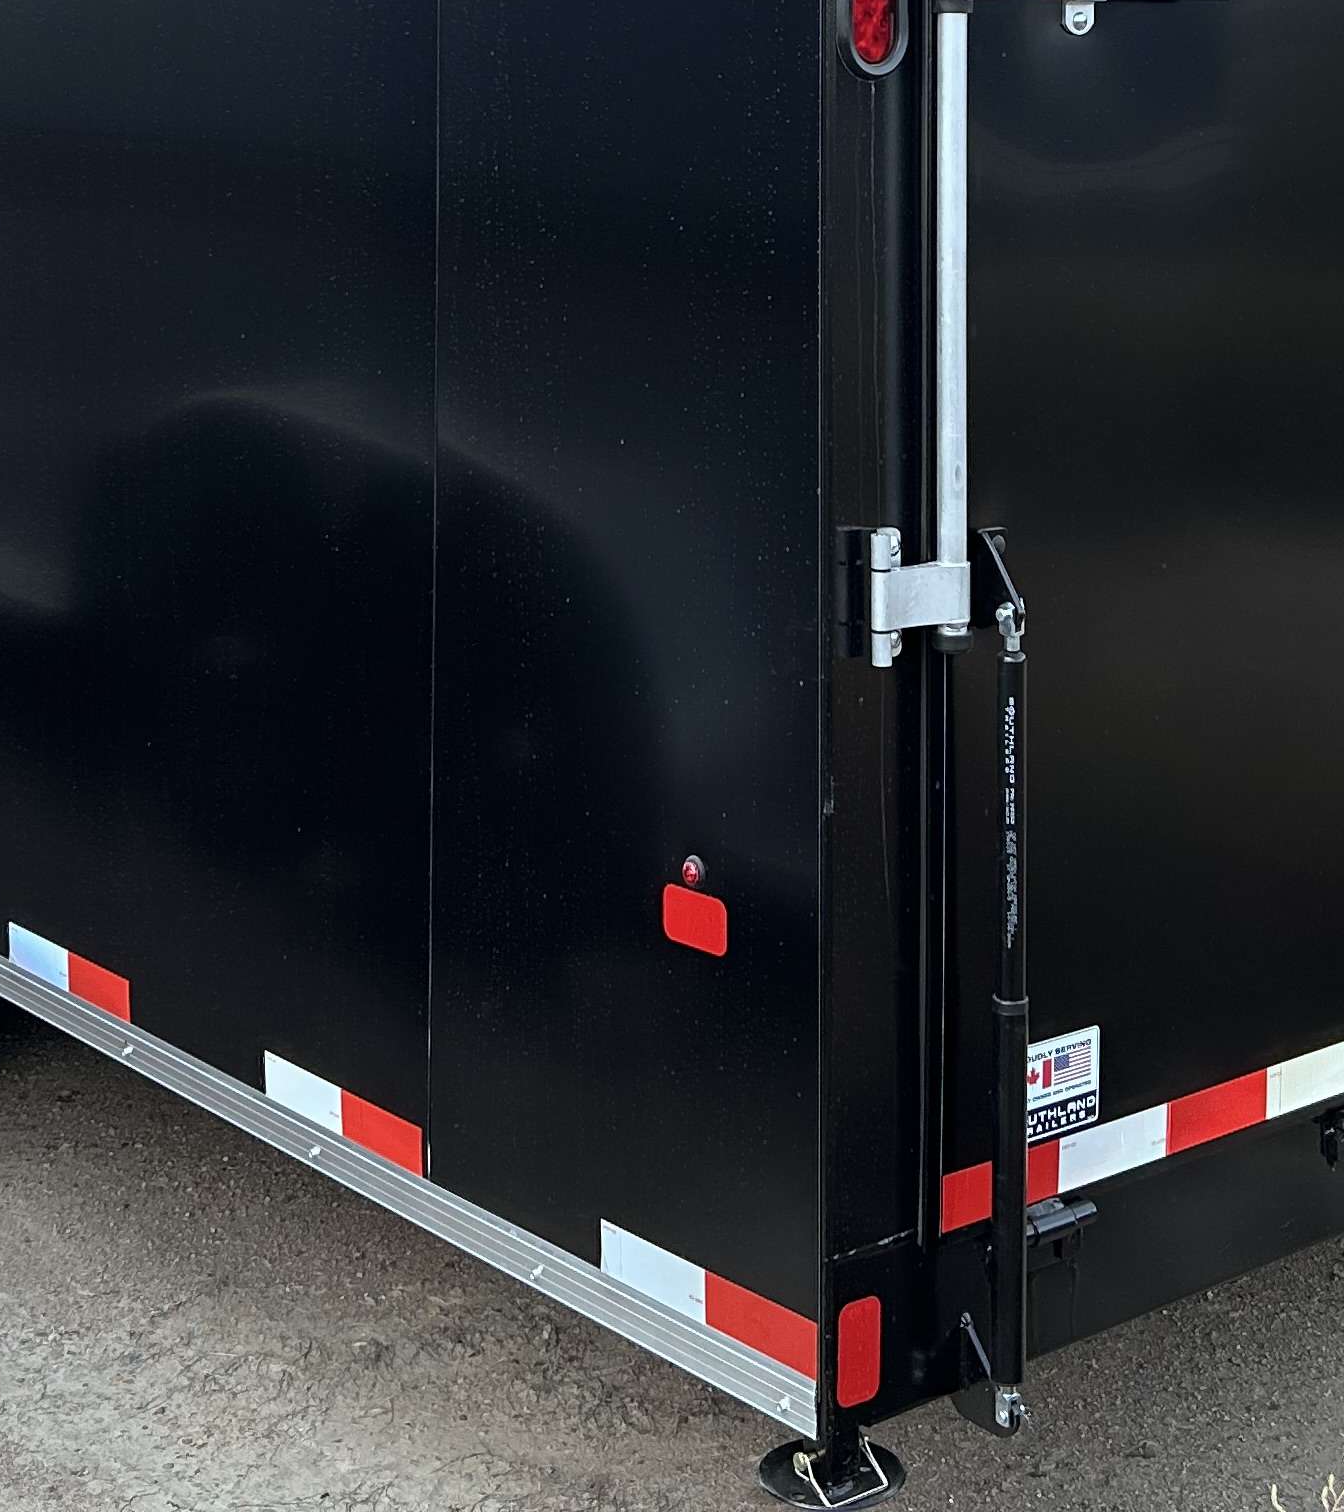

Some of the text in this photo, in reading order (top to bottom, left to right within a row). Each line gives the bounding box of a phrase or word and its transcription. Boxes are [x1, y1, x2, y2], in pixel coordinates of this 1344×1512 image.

[1055, 1038, 1092, 1055] SERVING
[1027, 1095, 1096, 1126] UTHLAND
[1027, 1110, 1086, 1136] RAILERS
